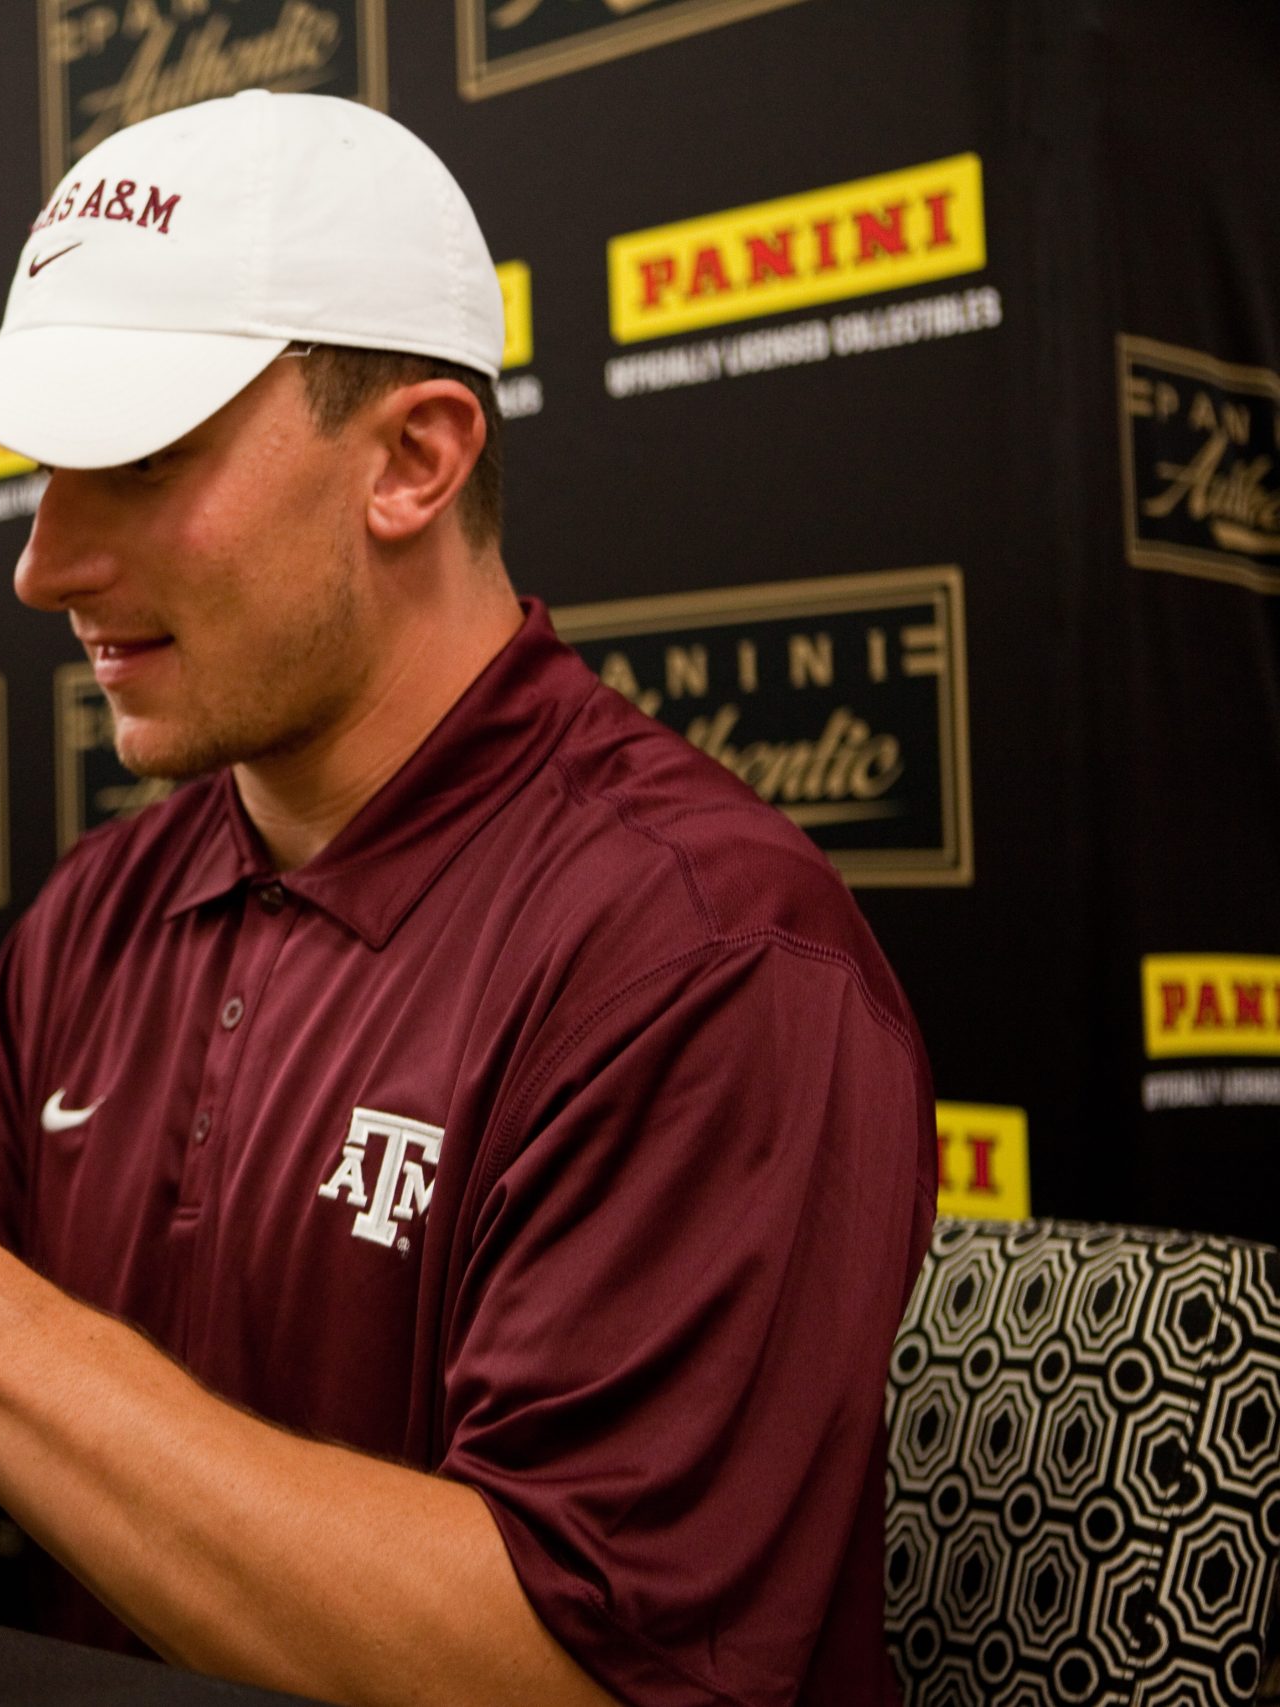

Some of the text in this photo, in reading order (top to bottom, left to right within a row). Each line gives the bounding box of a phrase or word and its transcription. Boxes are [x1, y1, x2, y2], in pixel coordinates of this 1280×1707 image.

[78, 178, 182, 234] A&M
[637, 188, 956, 312] PANINI
[600, 626, 888, 700] ANINI
